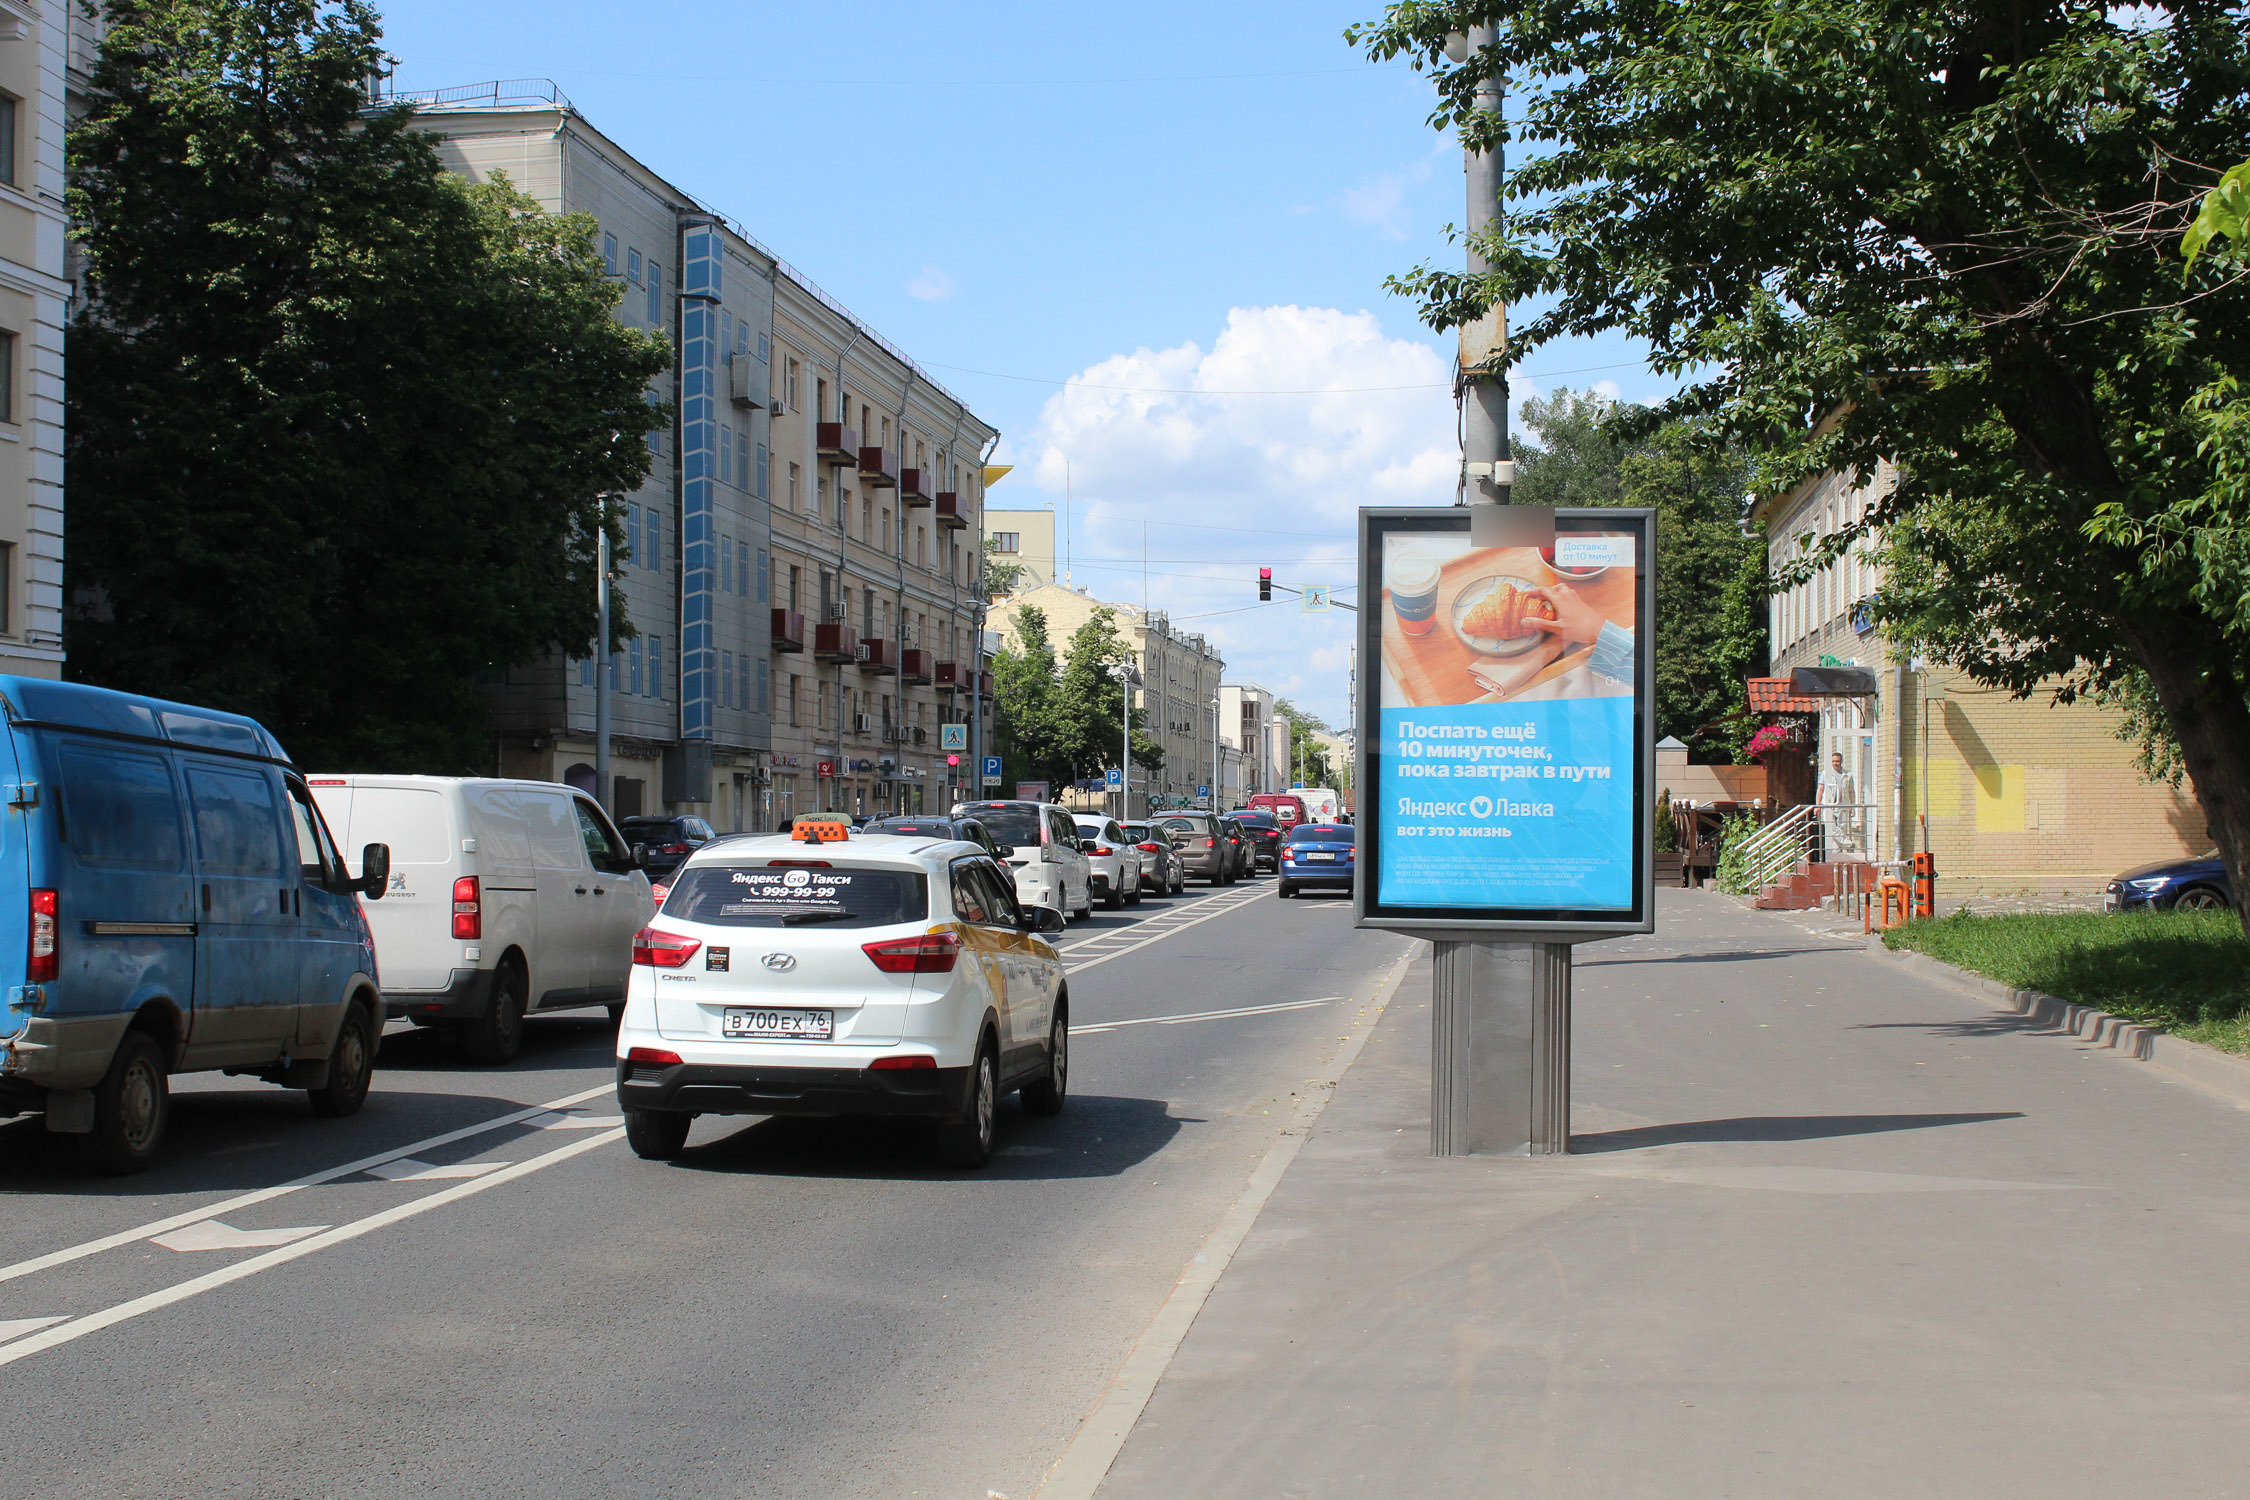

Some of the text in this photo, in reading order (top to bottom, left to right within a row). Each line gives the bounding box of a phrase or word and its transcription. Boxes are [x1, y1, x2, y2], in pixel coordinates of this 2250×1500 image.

[1563, 542, 1608, 553] Доставка
[1563, 552, 1618, 562] от 10 минут
[1605, 675, 1622, 687] 0+
[1398, 721, 1537, 742] Поспать ещё
[1398, 741, 1553, 761] 10 минуточек,
[987, 759, 998, 773] P
[1110, 771, 1118, 782] P
[1398, 763, 1611, 783] пока завтрак в пути
[1397, 798, 1554, 818] Яндекс Лавка
[1397, 825, 1512, 838] вот это жизнь
[731, 872, 852, 885] Яндекс Go Такси
[761, 887, 836, 897] 999-99-99
[661, 974, 697, 982] CRETA
